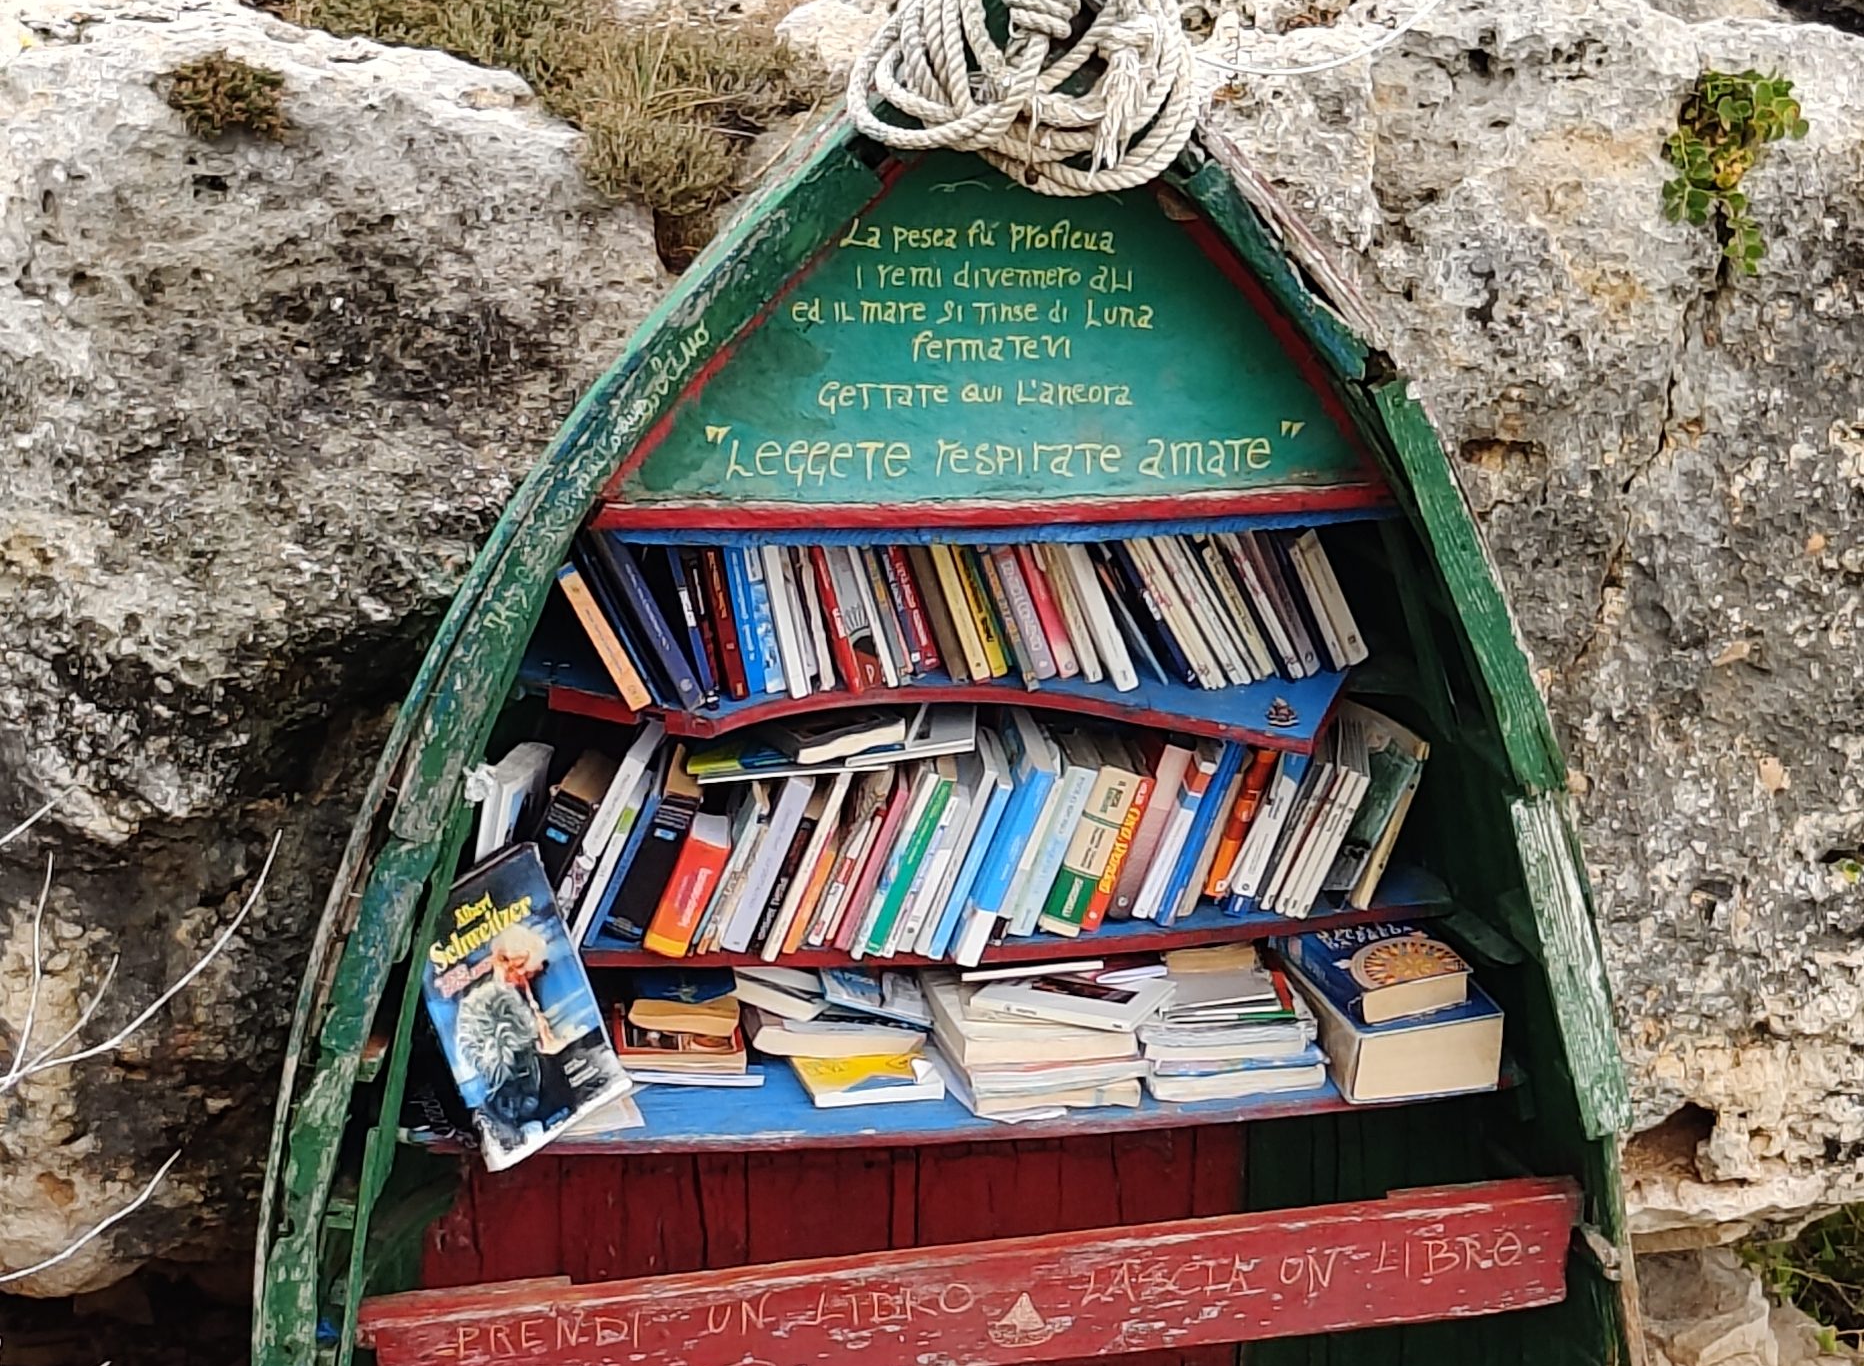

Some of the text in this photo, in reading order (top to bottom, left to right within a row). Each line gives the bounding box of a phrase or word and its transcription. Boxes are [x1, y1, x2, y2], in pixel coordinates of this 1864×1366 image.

[839, 218, 882, 248] La
[878, 263, 942, 289] remi
[953, 261, 1081, 289] divennero
[791, 298, 823, 324] ed
[860, 301, 927, 323] mare
[1048, 297, 1068, 323] di
[936, 438, 1123, 479] respirate
[429, 896, 532, 975] Schweitzer
[1081, 1253, 1250, 1307] LASCIA
[1371, 1232, 1523, 1280] LIBRO
[457, 1284, 976, 1359] PRENDI UN LIBRO
